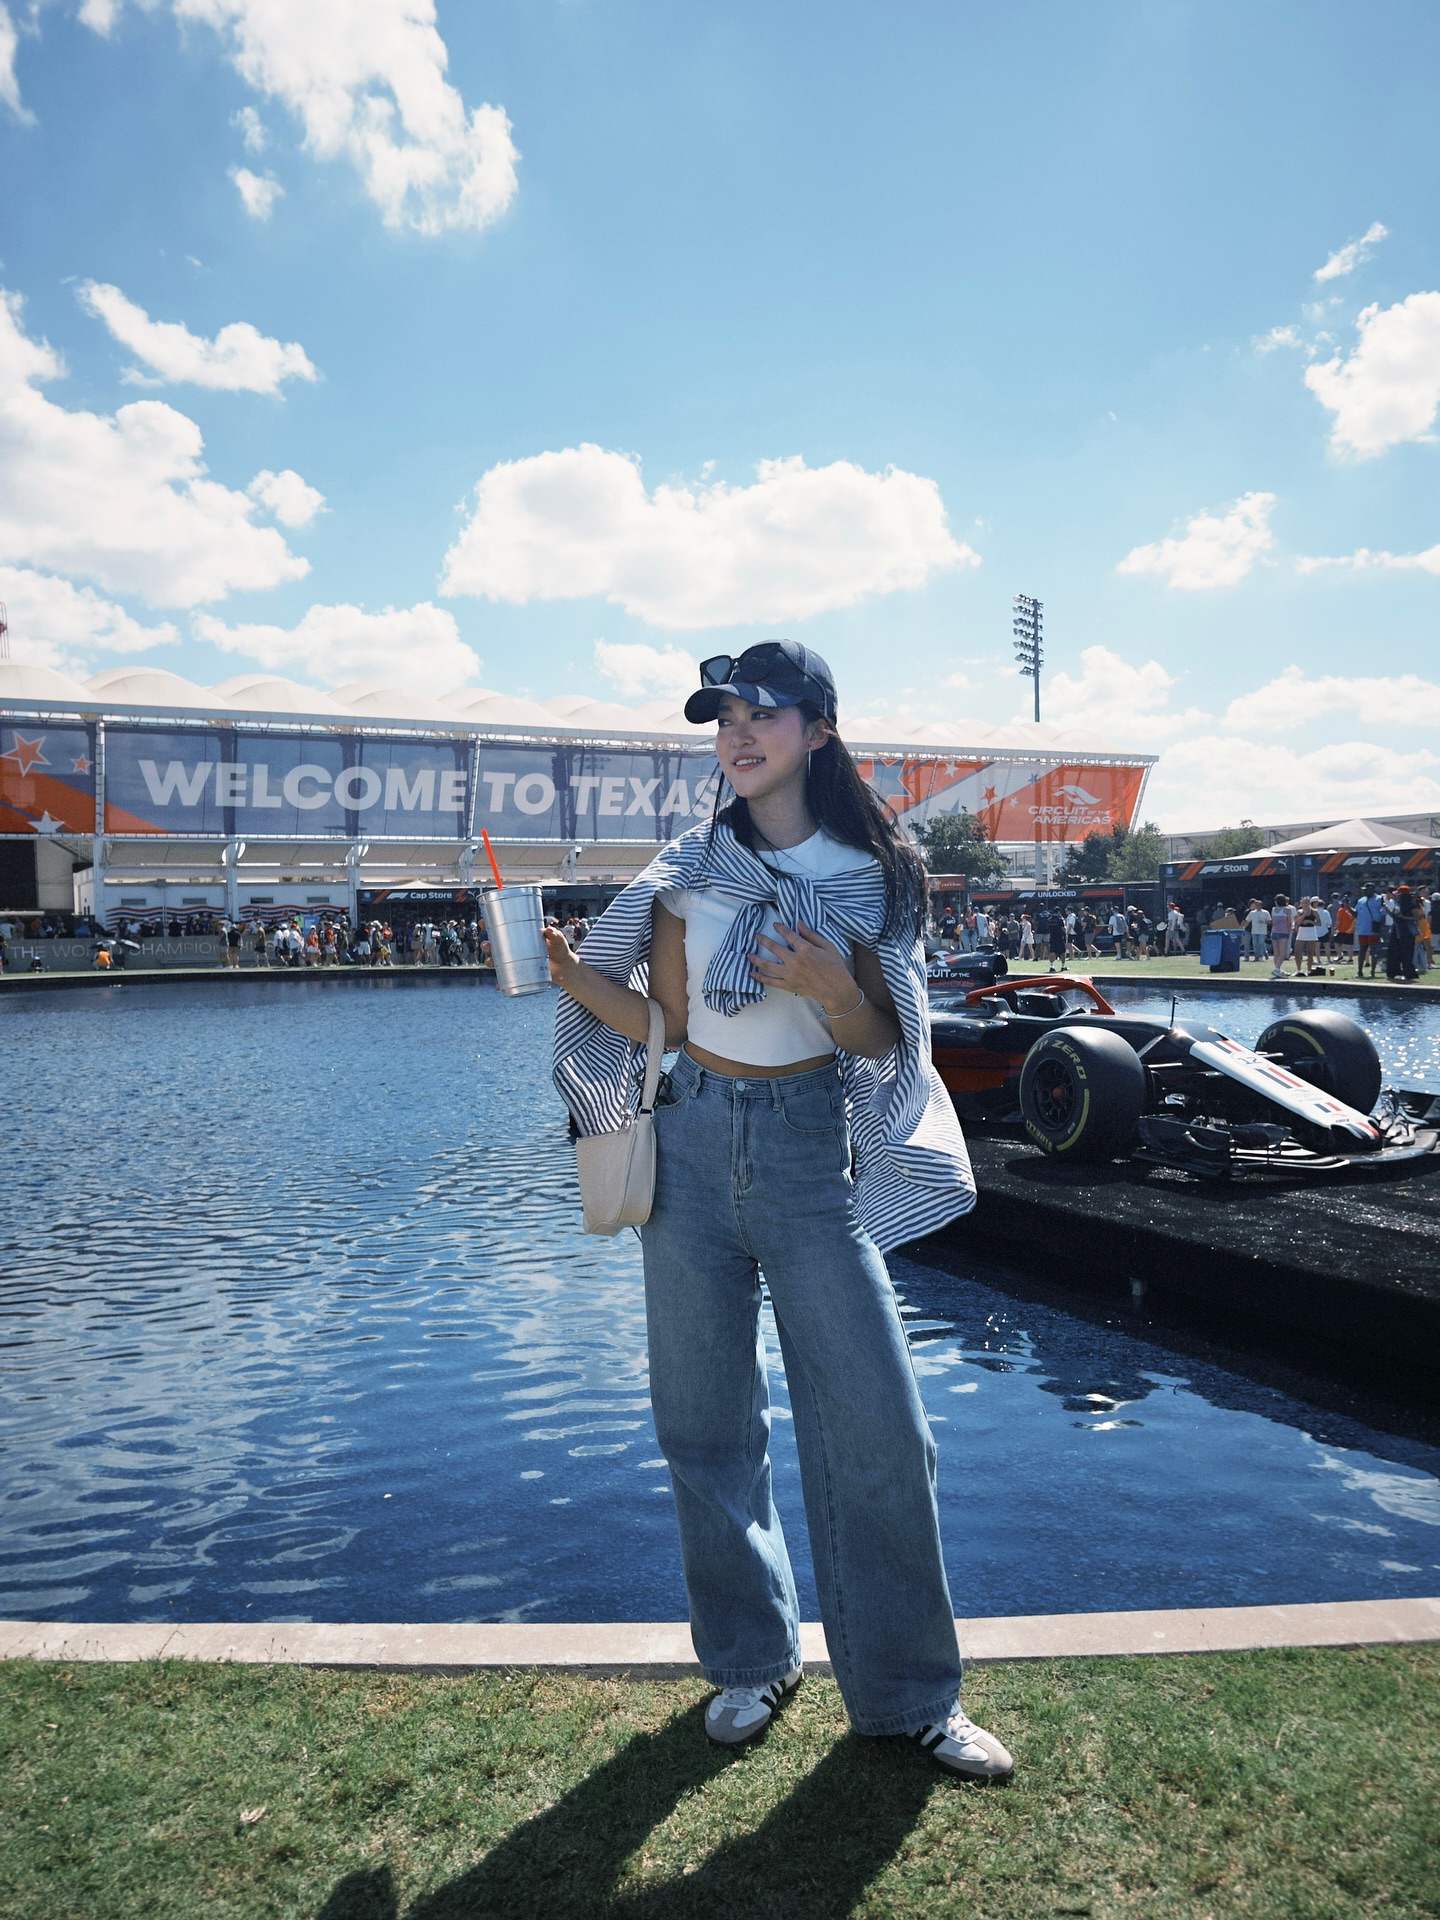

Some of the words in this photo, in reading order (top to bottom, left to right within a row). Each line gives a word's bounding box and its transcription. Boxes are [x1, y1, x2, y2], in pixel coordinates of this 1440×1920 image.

[138, 760, 468, 812] WELCOME
[482, 771, 556, 815] TO
[569, 776, 719, 818] TEXAS
[1028, 805, 1089, 815] CIRCUIT
[1032, 816, 1112, 825] AMERICAS
[1371, 856, 1400, 865] Store
[1223, 864, 1249, 873] Store
[410, 892, 427, 900] Cap
[428, 891, 453, 899] Store
[10, 945, 46, 959] THE
[52, 944, 122, 958] WOD
[1052, 1039, 1087, 1080] ZERO
